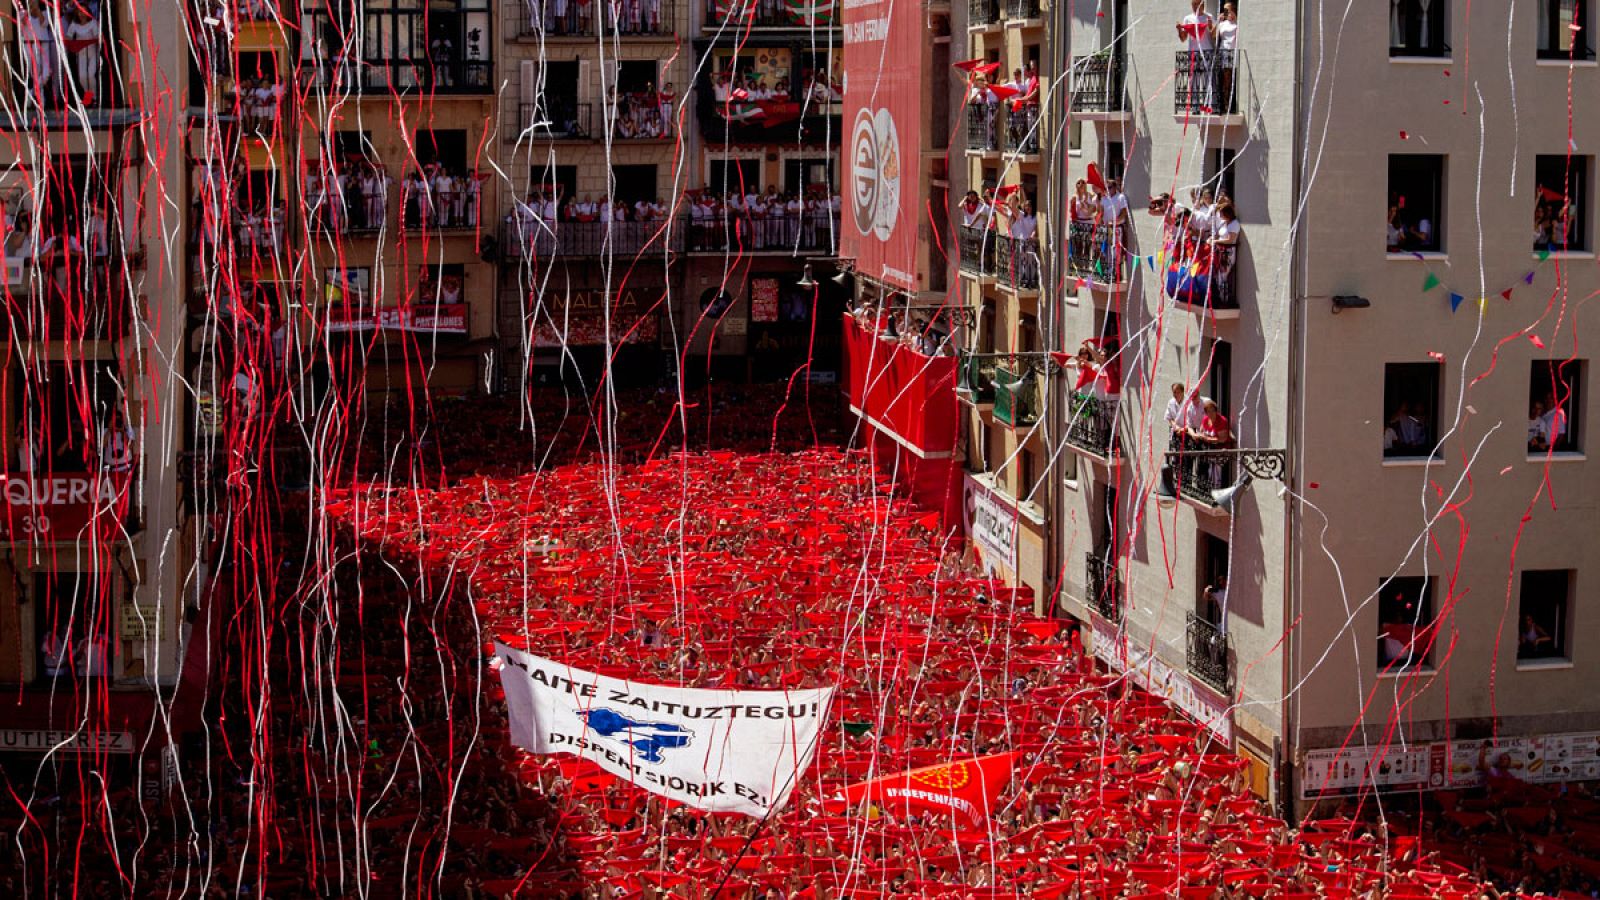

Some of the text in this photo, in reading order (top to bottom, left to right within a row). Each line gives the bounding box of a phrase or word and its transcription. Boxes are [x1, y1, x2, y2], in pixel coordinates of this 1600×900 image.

[552, 290, 637, 310] MALTEA
[0, 478, 118, 505] QUERIA
[22, 515, 50, 533] 30
[609, 688, 818, 720] ZAITUZTEGU!
[5, 730, 123, 748] UTIERREZ
